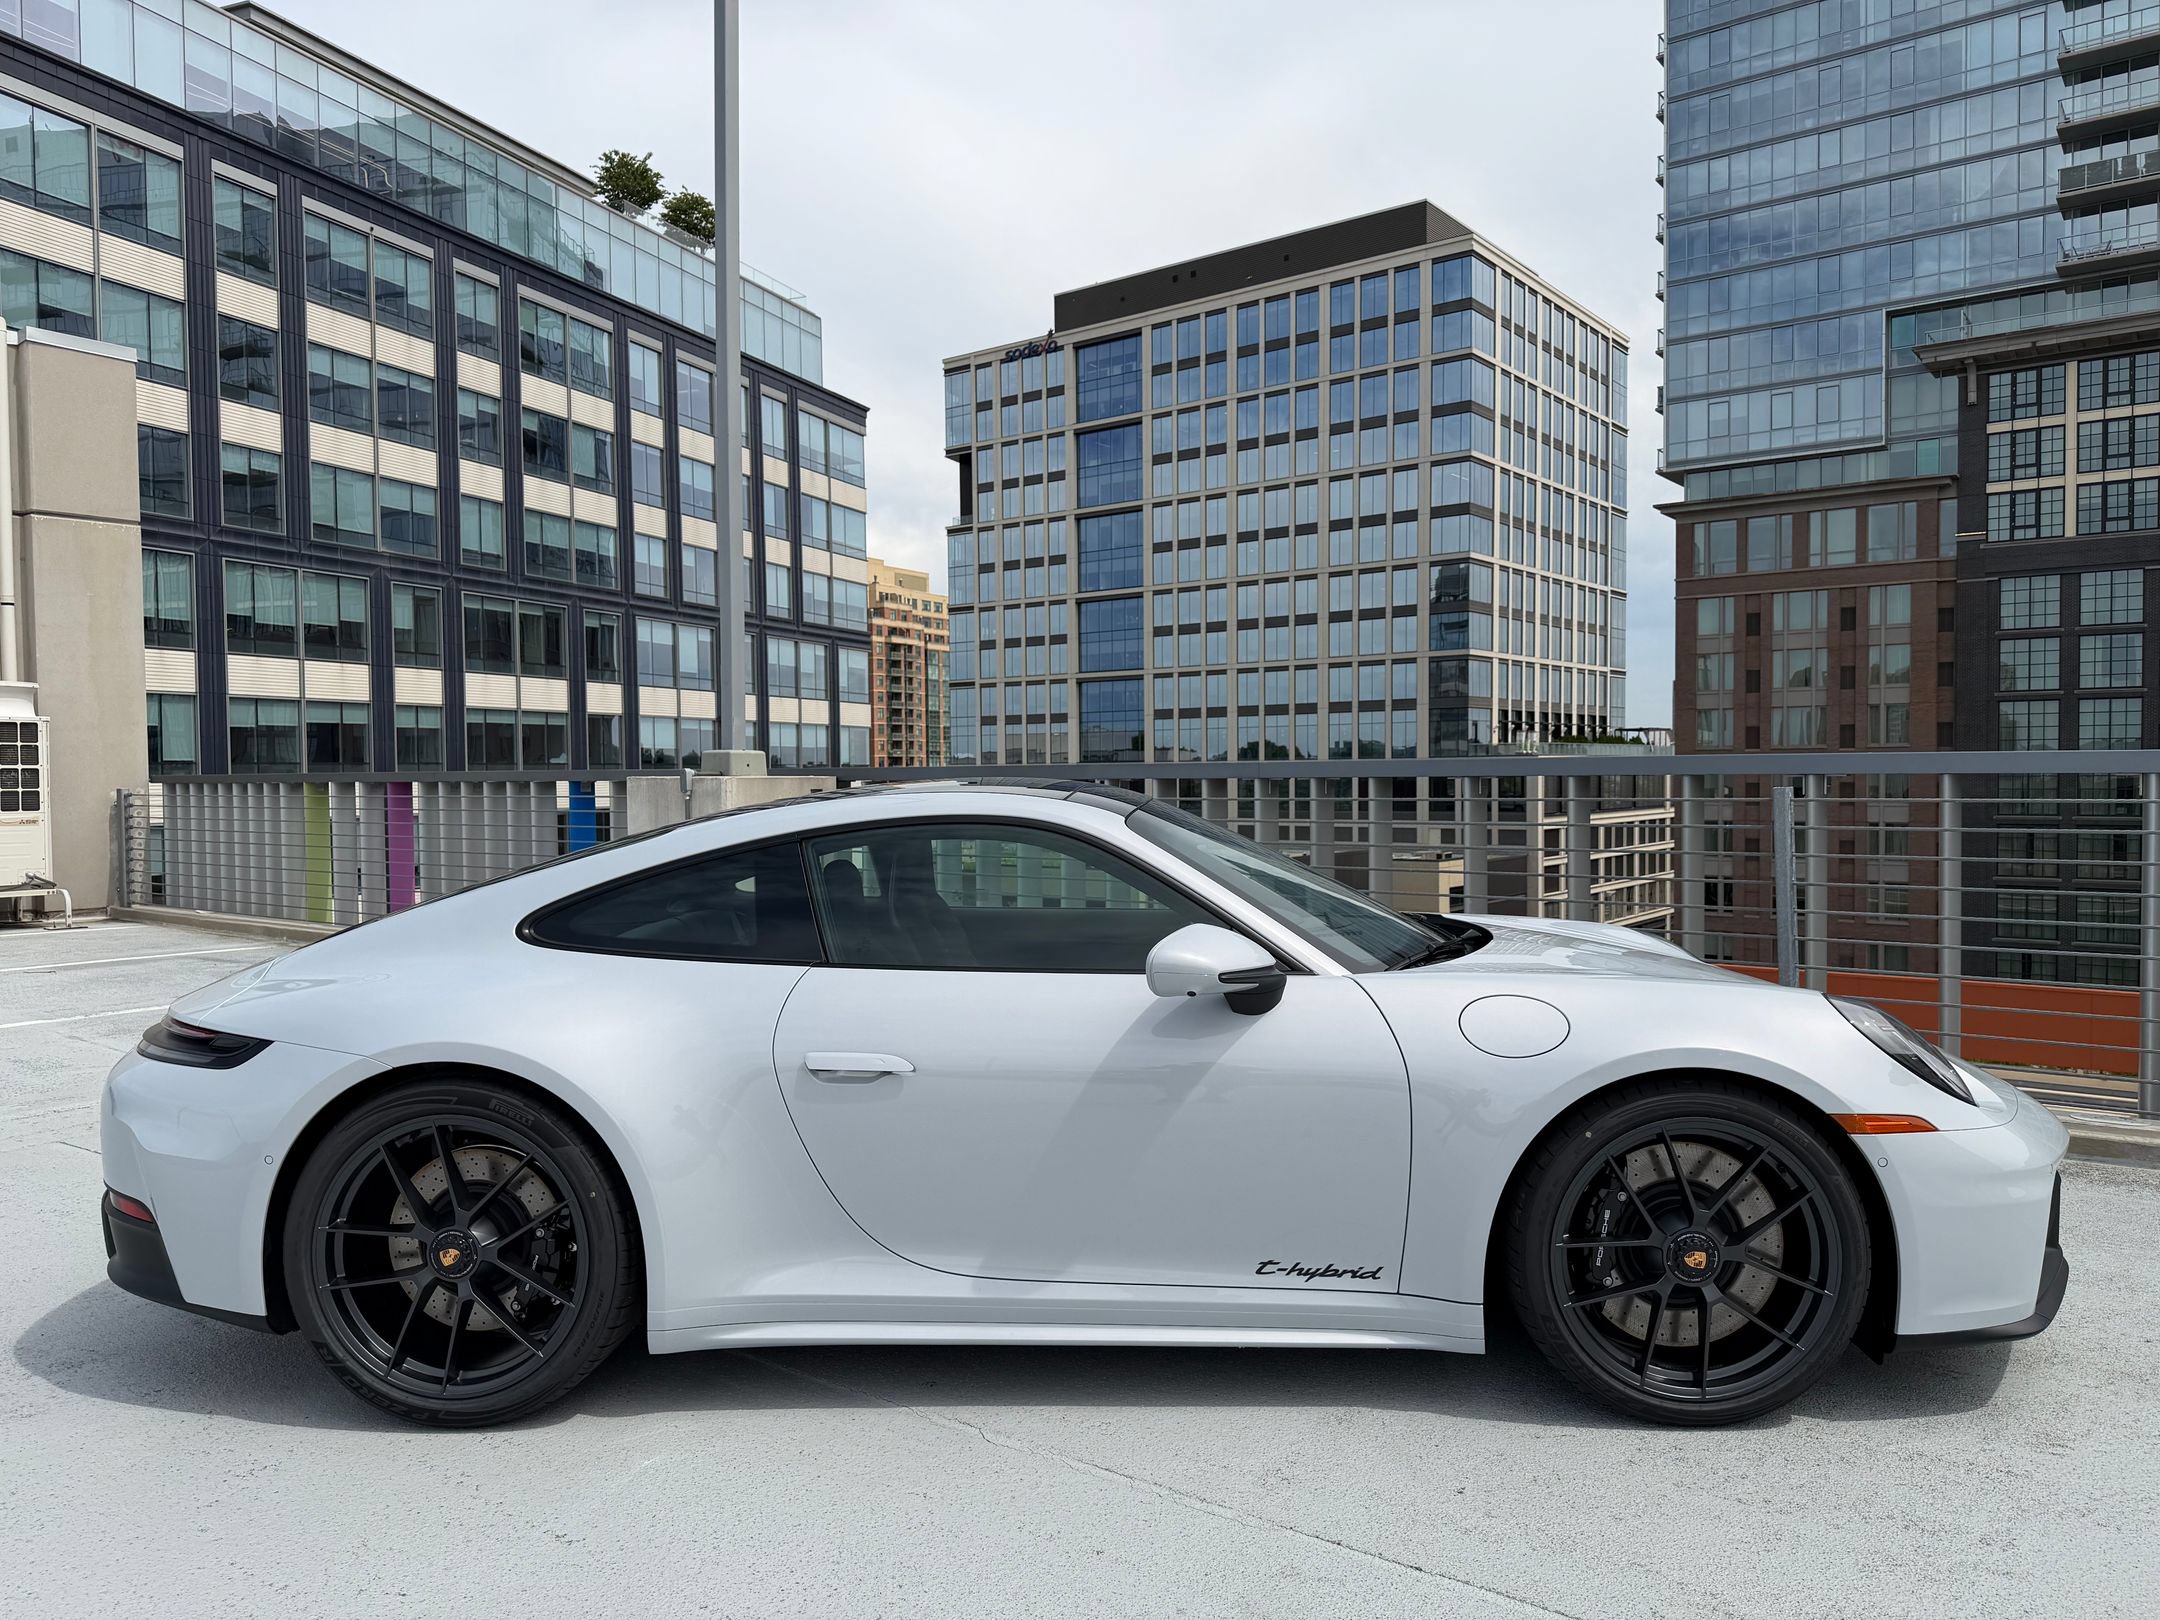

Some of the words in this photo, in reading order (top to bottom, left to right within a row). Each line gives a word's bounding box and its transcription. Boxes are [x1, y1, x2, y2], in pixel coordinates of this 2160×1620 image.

[1005, 333, 1058, 360] sodexo
[488, 1097, 535, 1127] PIRELLI
[1255, 1259, 1385, 1283] t-hybrid
